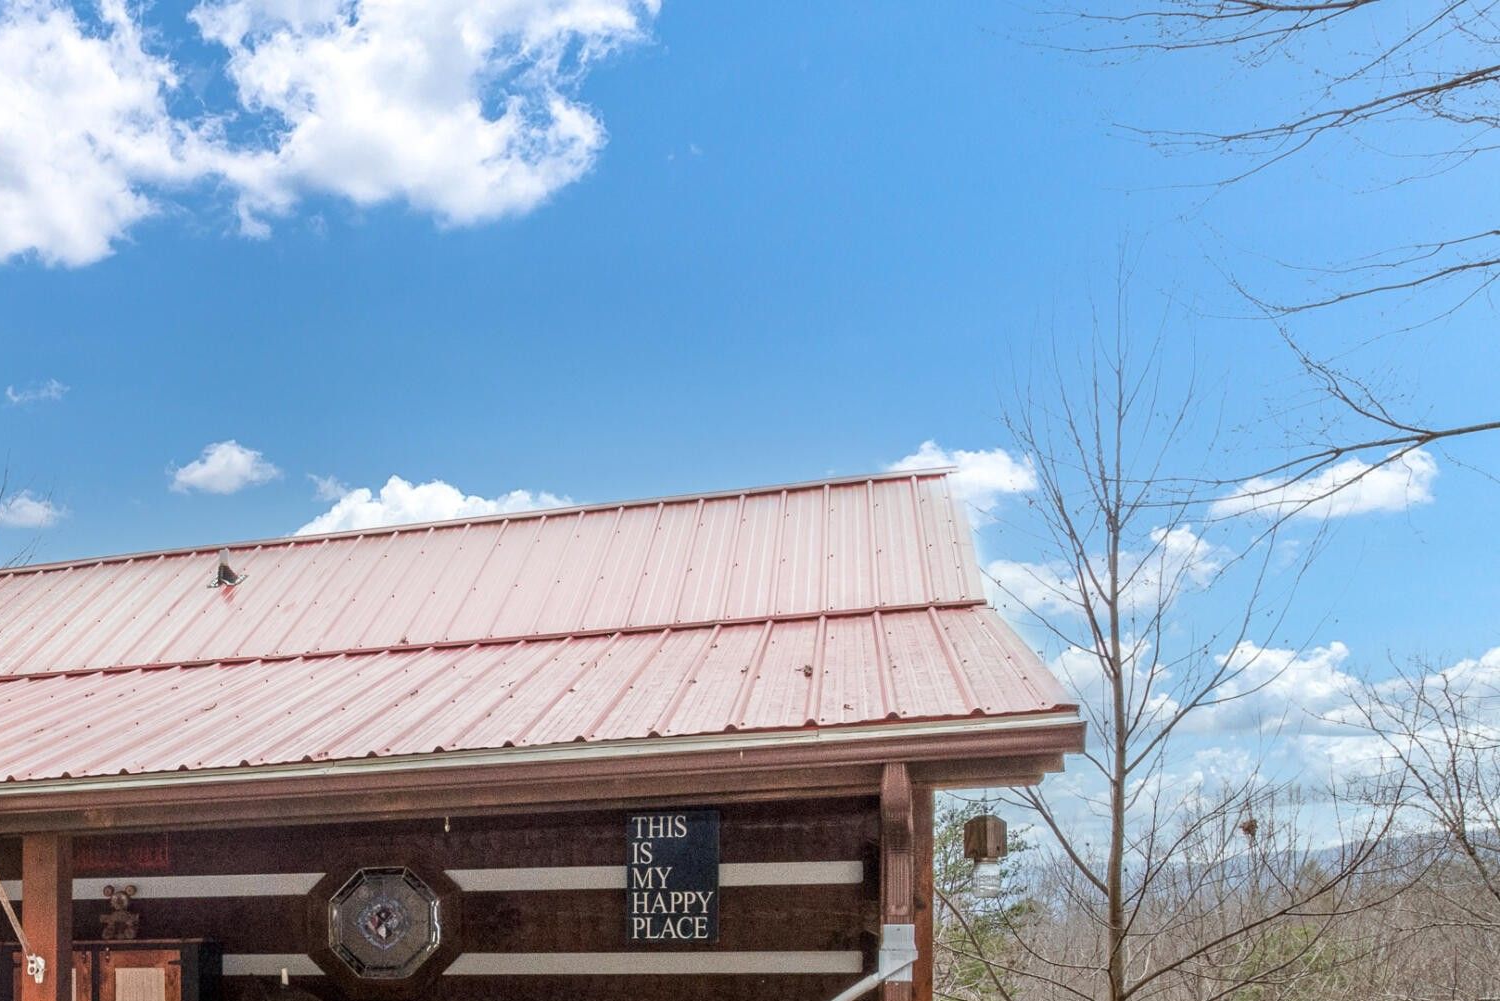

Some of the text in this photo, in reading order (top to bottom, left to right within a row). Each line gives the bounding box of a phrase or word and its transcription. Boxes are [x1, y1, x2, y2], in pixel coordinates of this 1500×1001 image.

[631, 815, 687, 838] THIS
[631, 842, 653, 864] IS
[631, 867, 672, 889] MY
[631, 891, 713, 914] HAPPY
[631, 917, 708, 938] PLACE
